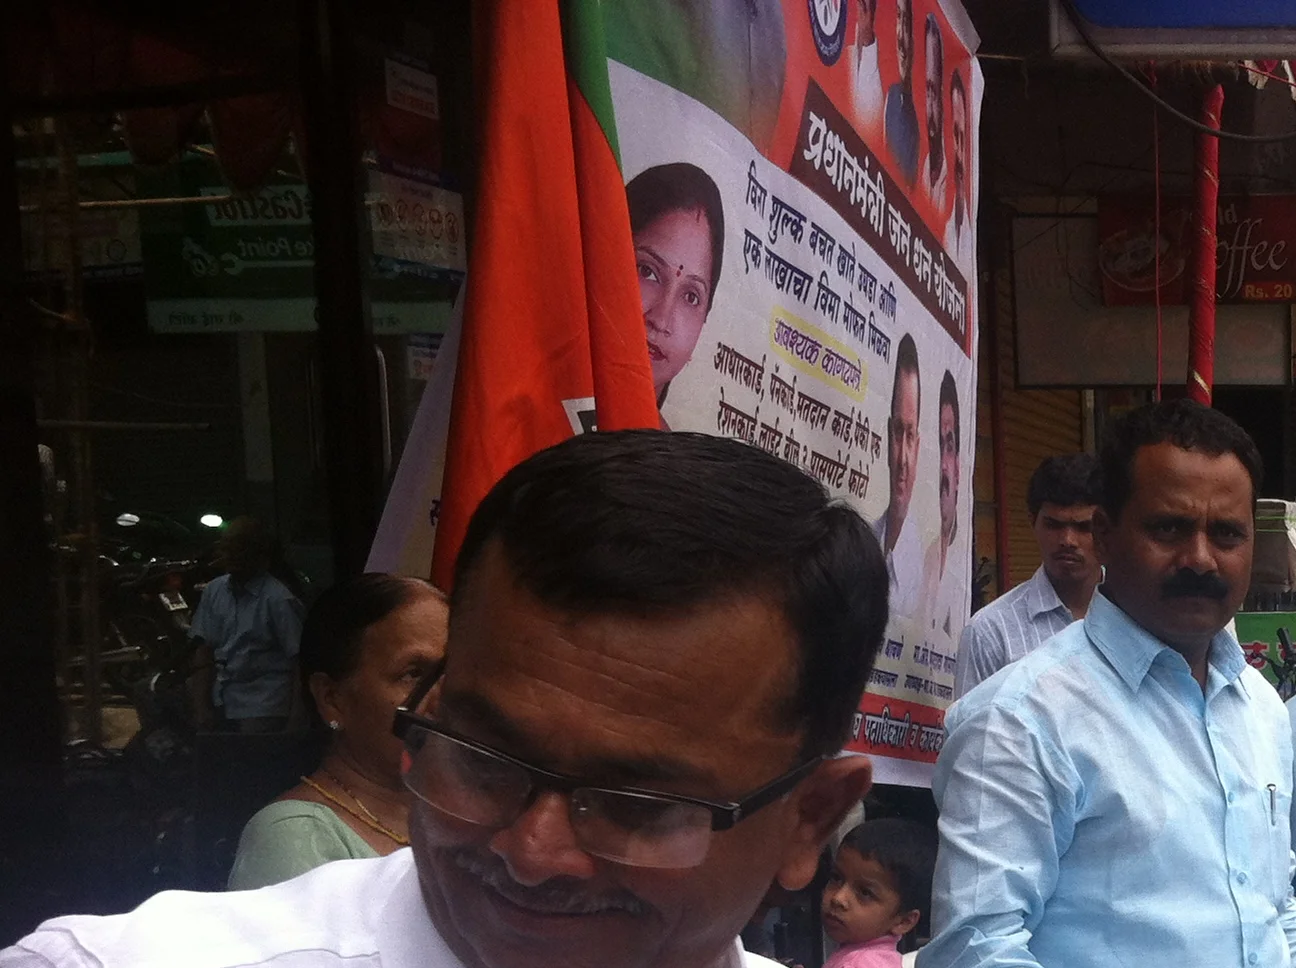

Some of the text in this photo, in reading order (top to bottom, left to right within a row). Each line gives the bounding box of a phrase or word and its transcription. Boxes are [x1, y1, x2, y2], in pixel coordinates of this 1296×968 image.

[888, 205, 912, 267] जन
[913, 237, 933, 293] धन
[1244, 283, 1293, 298] Rs. 20
